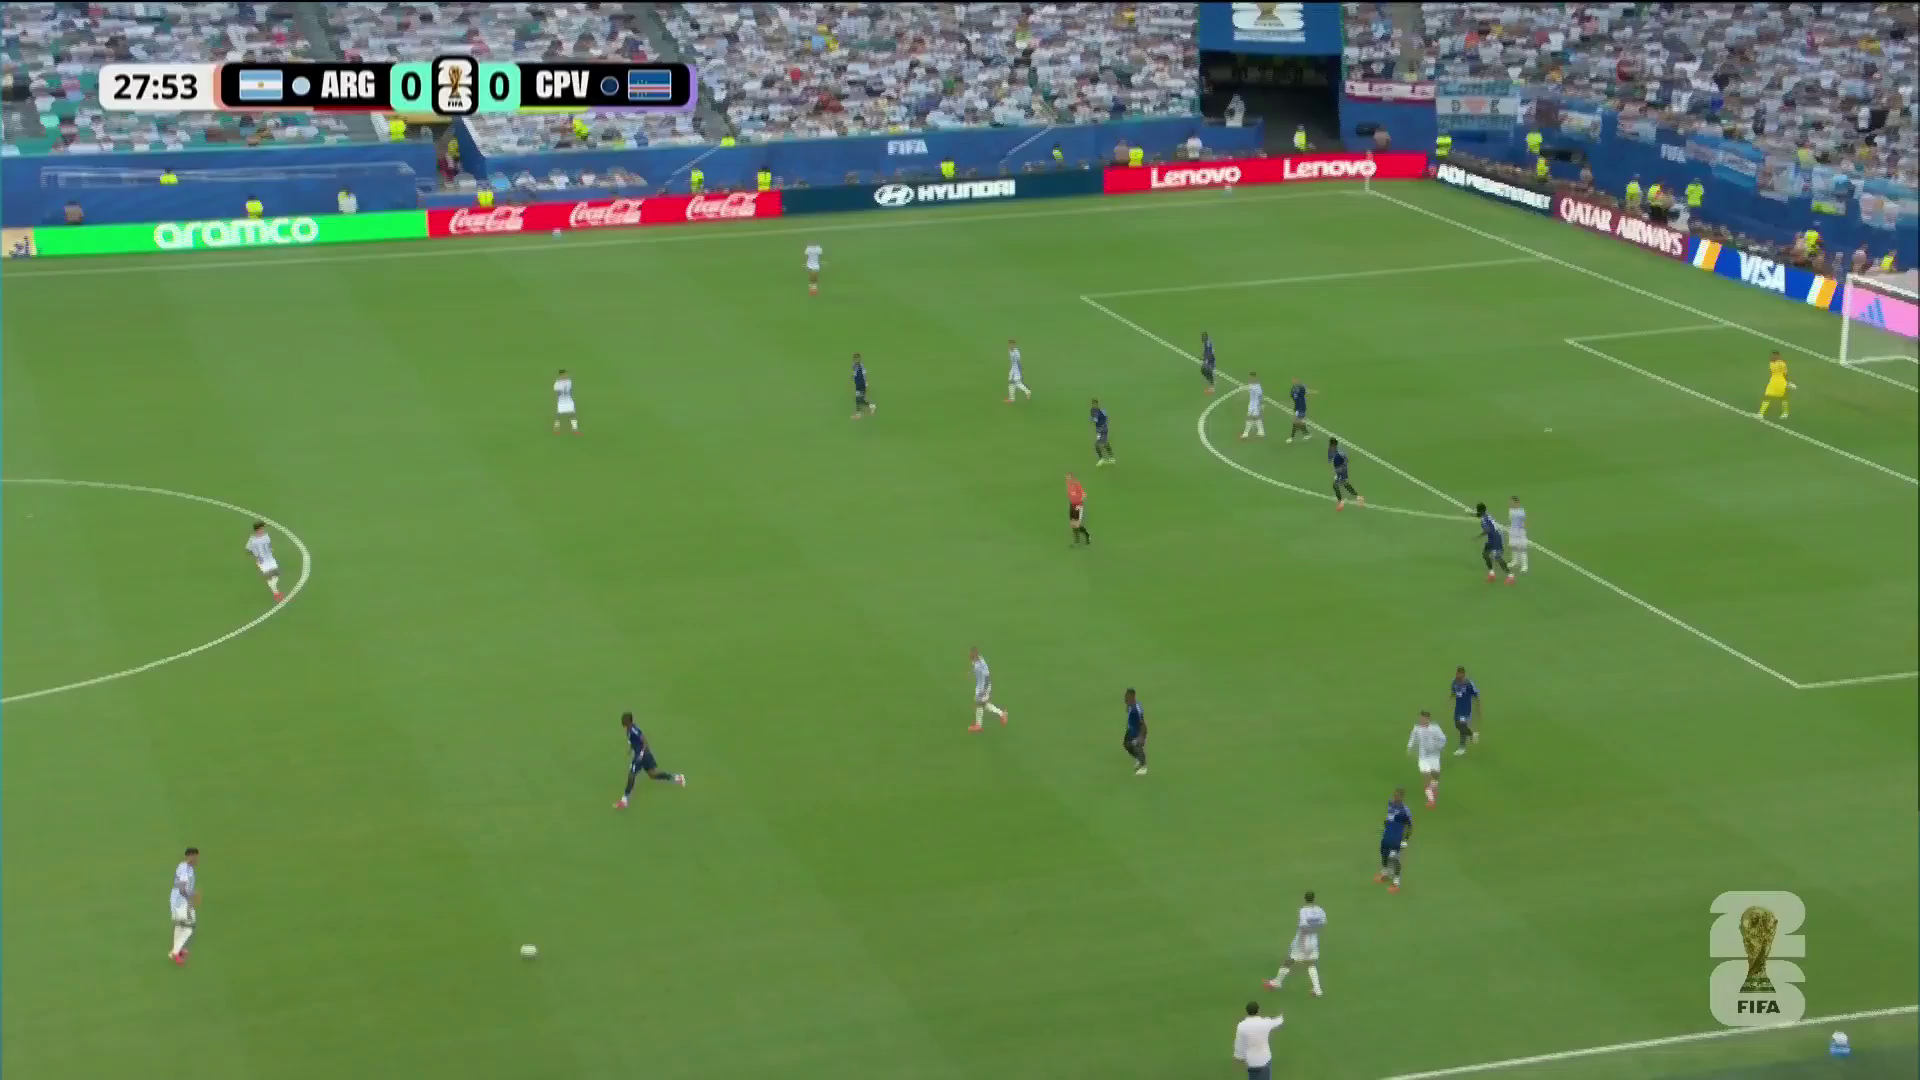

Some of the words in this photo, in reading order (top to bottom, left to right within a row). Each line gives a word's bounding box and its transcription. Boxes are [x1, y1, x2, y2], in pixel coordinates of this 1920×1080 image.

[888, 139, 928, 155] FIFA
[1151, 165, 1242, 188] Lenovo
[1283, 157, 1377, 180] Lenovo
[917, 178, 1016, 202] HYUNDAI
[153, 216, 319, 250] aramco
[1559, 197, 1612, 232] QATAR
[1616, 214, 1684, 256] AIRWAYS
[1736, 249, 1786, 293] VISA
